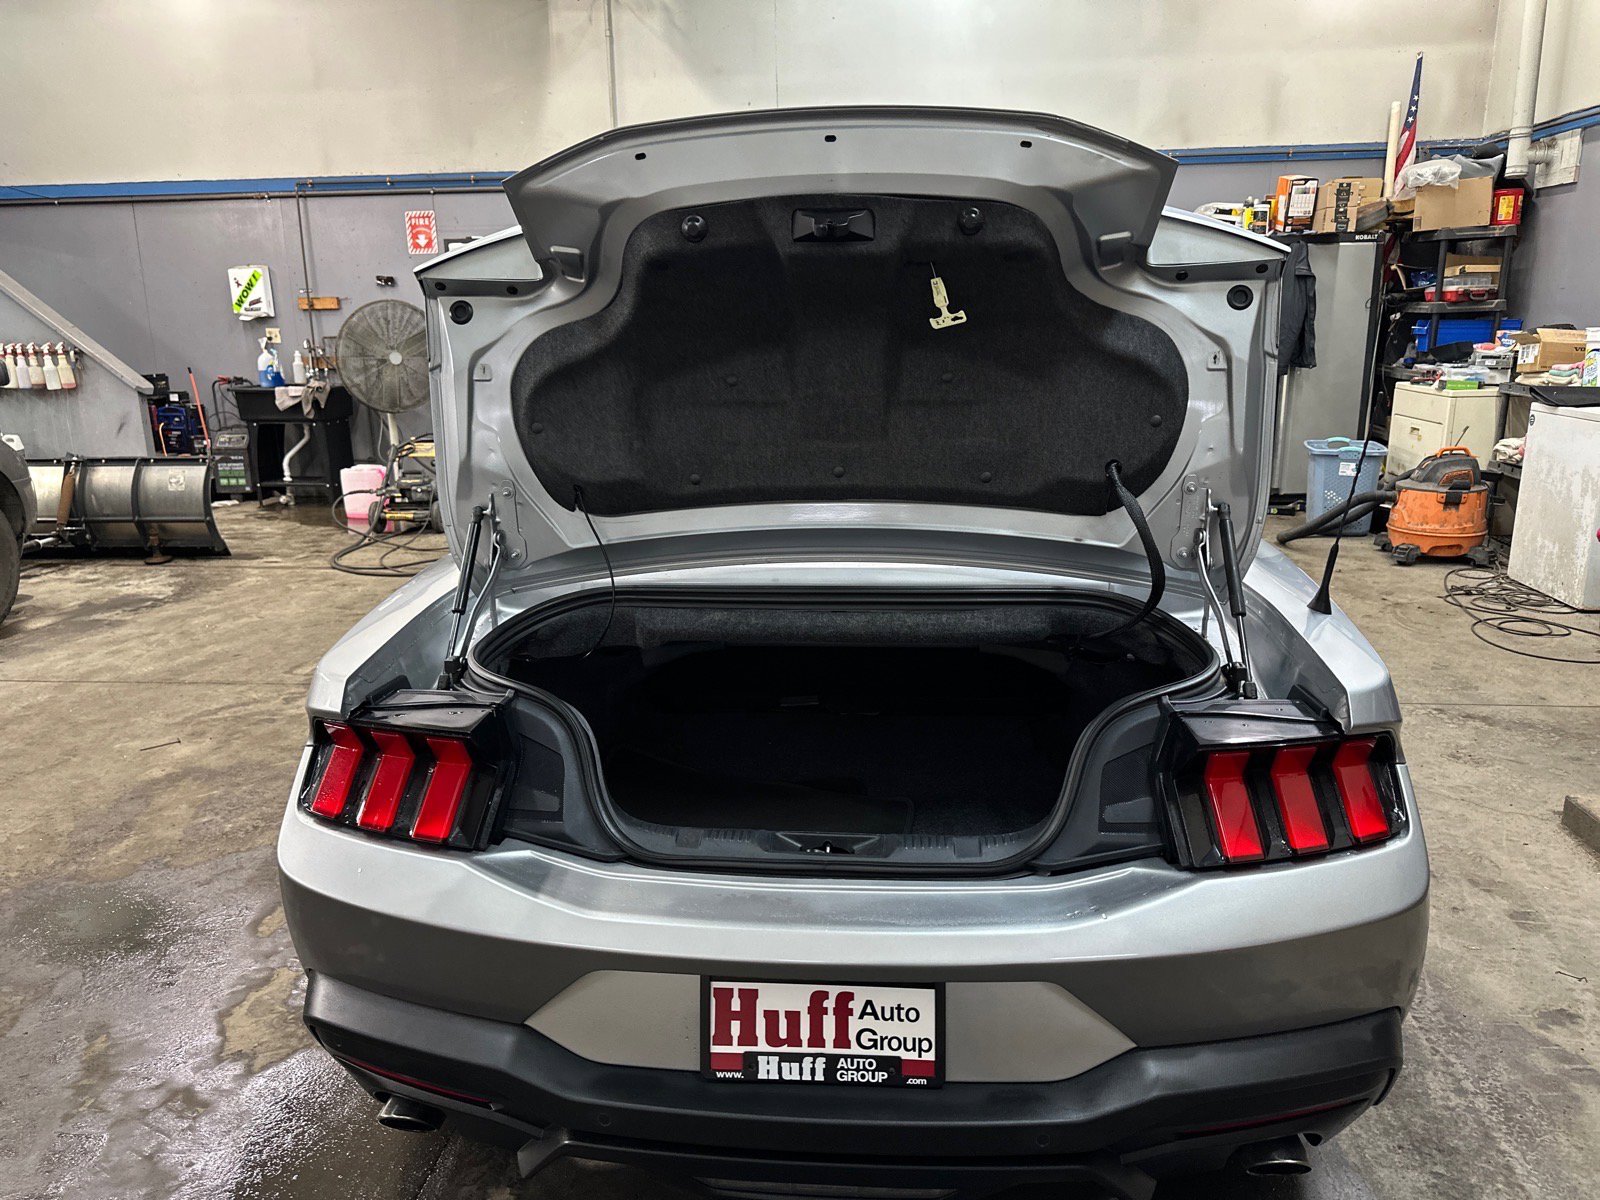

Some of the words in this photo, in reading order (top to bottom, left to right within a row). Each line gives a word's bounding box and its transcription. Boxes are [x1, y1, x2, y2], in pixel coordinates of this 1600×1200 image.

[411, 217, 429, 225] FIRE
[712, 987, 855, 1049] Huff
[858, 999, 920, 1023] Auto
[855, 1027, 933, 1058] Group
[716, 1071, 745, 1079] www.
[757, 1055, 827, 1081] Huff
[836, 1058, 877, 1070] AUTO
[836, 1070, 889, 1083] GROUP
